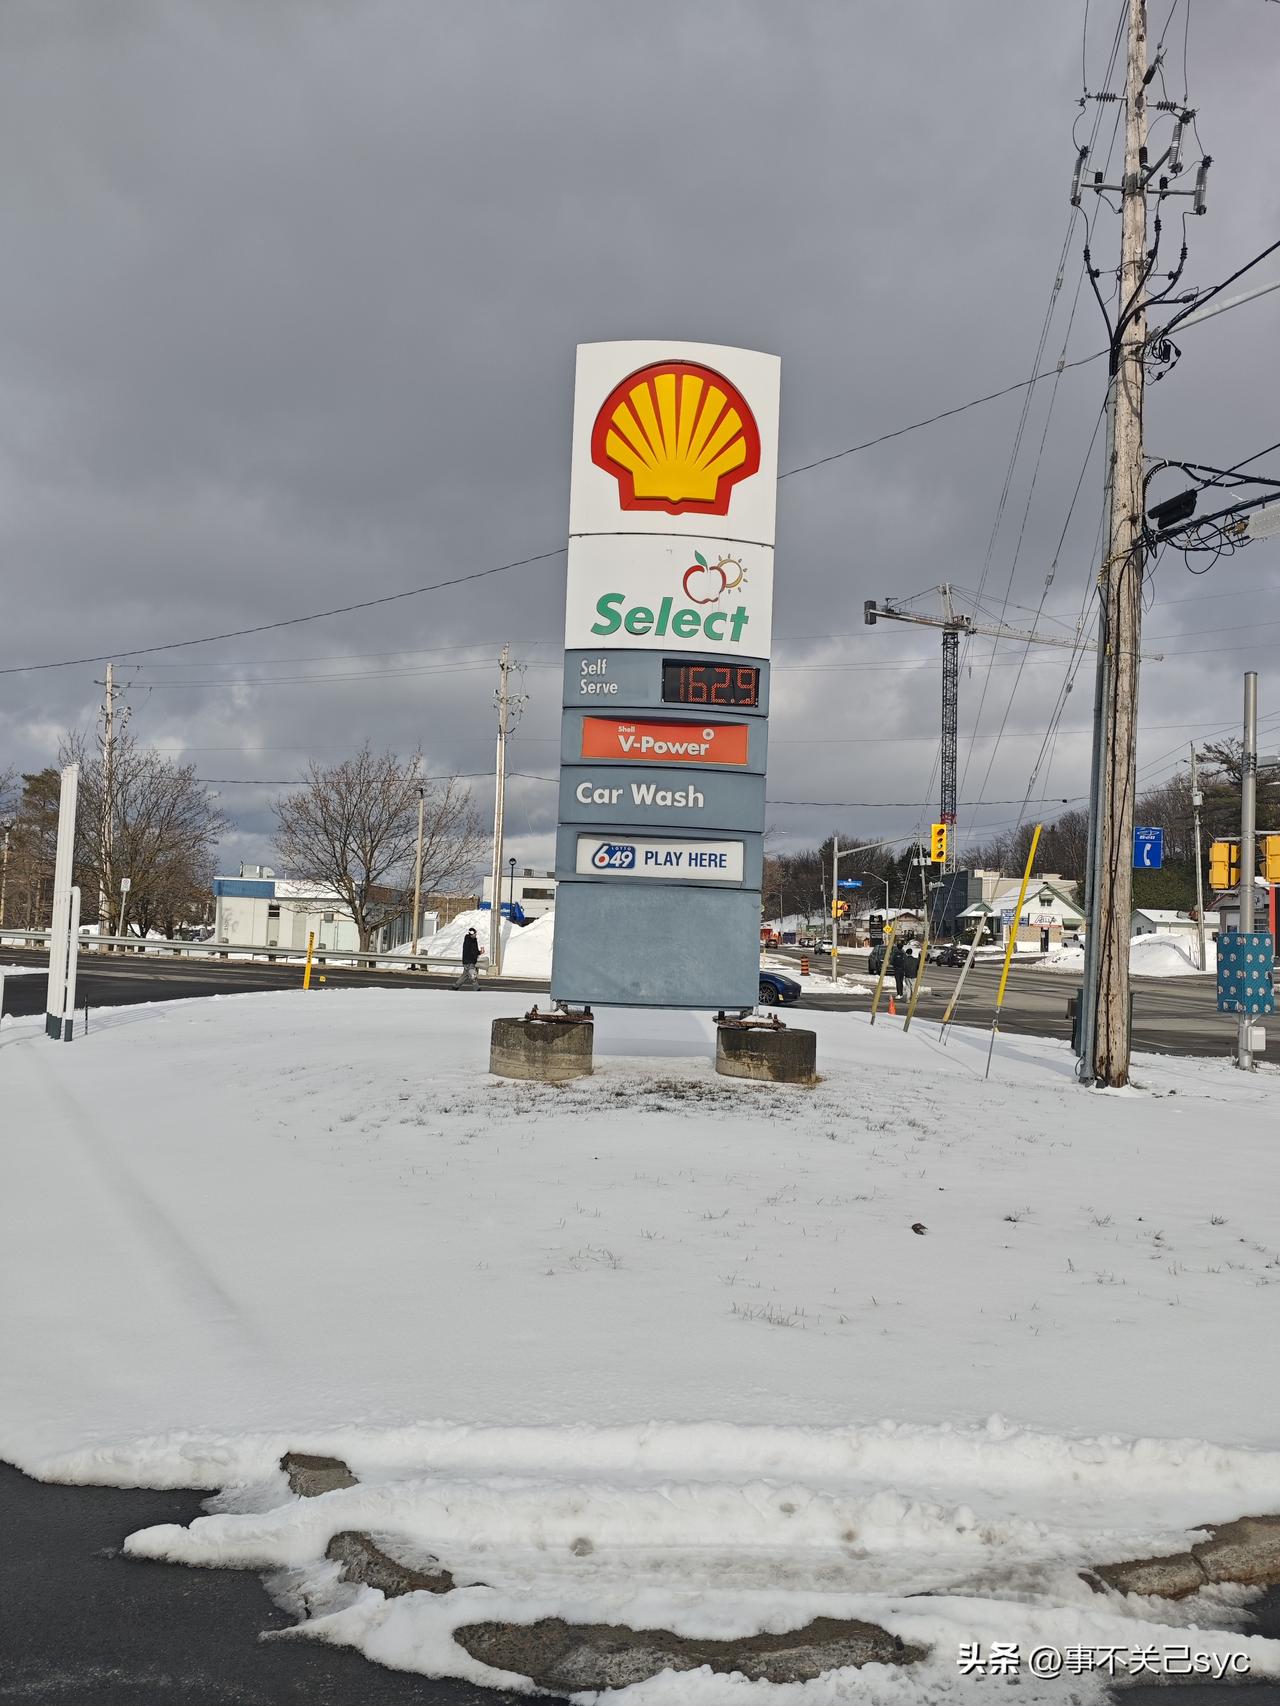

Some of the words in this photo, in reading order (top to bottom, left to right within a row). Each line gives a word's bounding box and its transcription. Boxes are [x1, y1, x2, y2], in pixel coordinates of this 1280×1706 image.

[590, 592, 749, 642] Select
[580, 658, 607, 675] Self
[580, 679, 618, 694] Serve
[679, 666, 756, 705] 162.9
[617, 725, 636, 733] Shell
[618, 734, 710, 756] V-Power
[576, 782, 624, 804] Car
[631, 783, 704, 808] Wash
[594, 845, 633, 867] 649
[644, 850, 682, 867] PLAY
[689, 852, 727, 868] HERE
